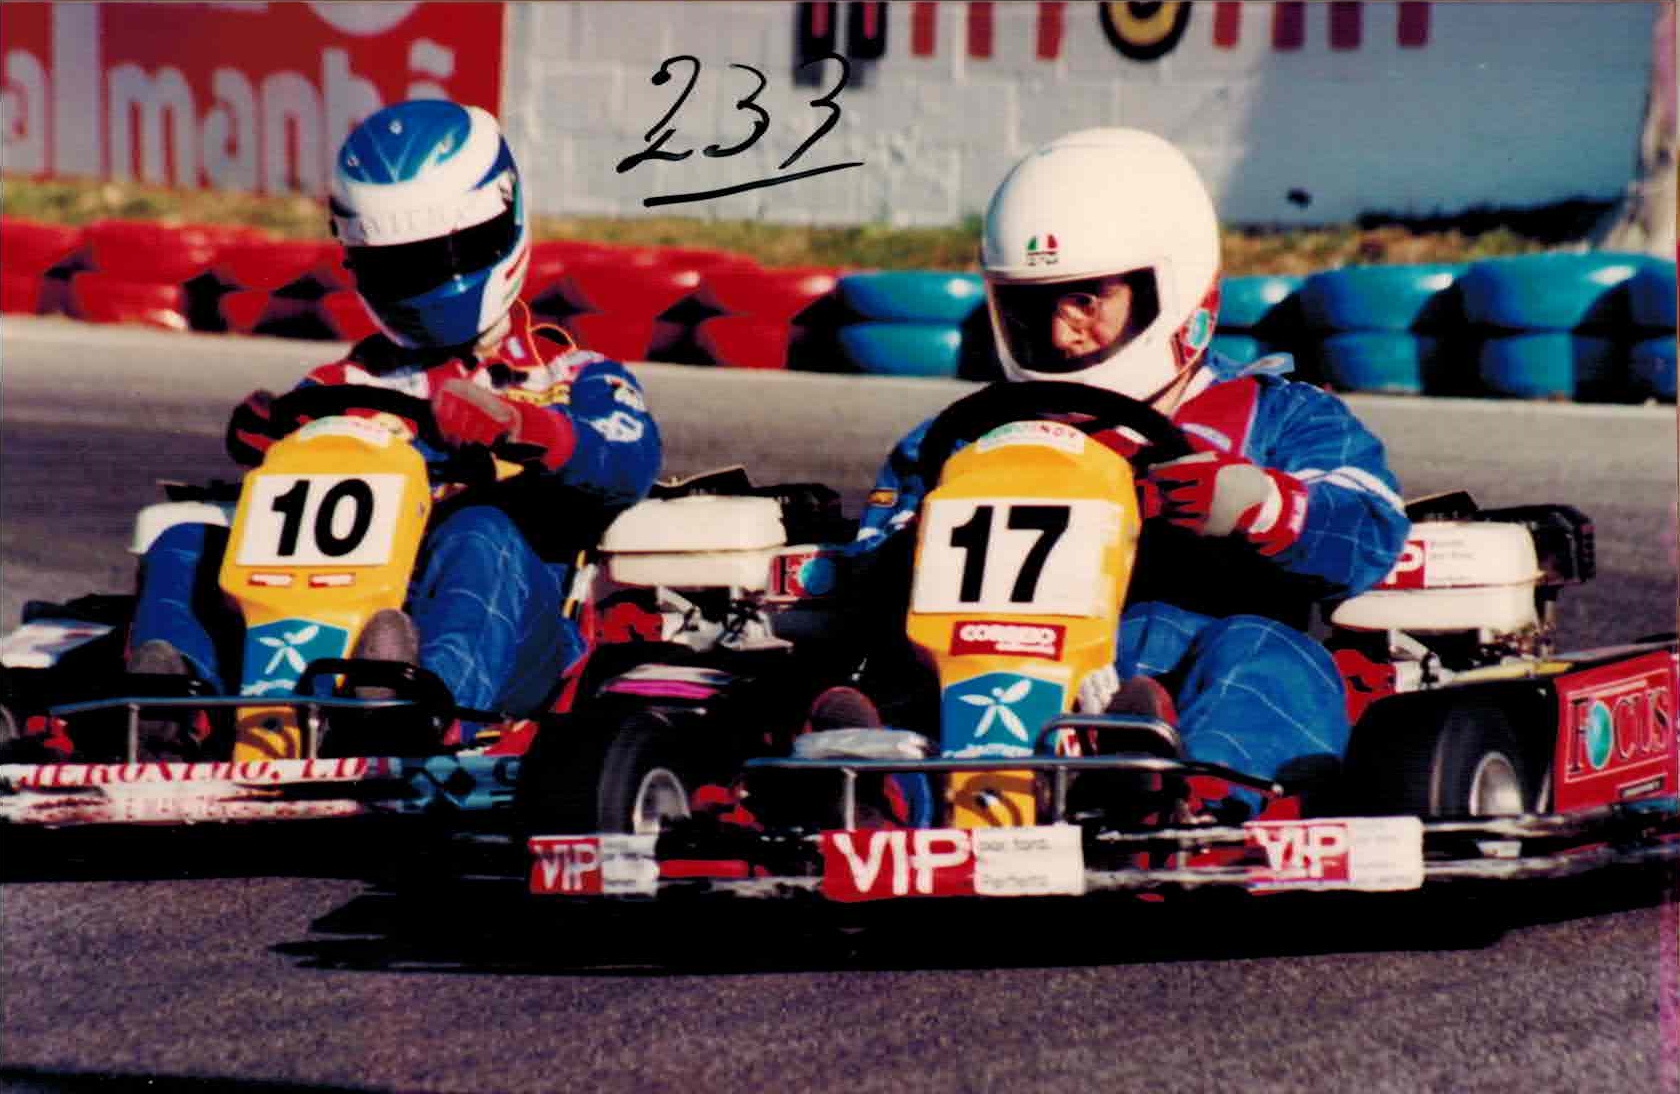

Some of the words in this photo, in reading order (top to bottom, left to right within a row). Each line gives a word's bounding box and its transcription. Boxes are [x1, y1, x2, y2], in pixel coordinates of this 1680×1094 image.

[616, 54, 848, 174] 233
[271, 478, 376, 557] 10
[949, 504, 1072, 604] 17
[534, 842, 600, 890] VIP
[832, 829, 972, 895] VIP
